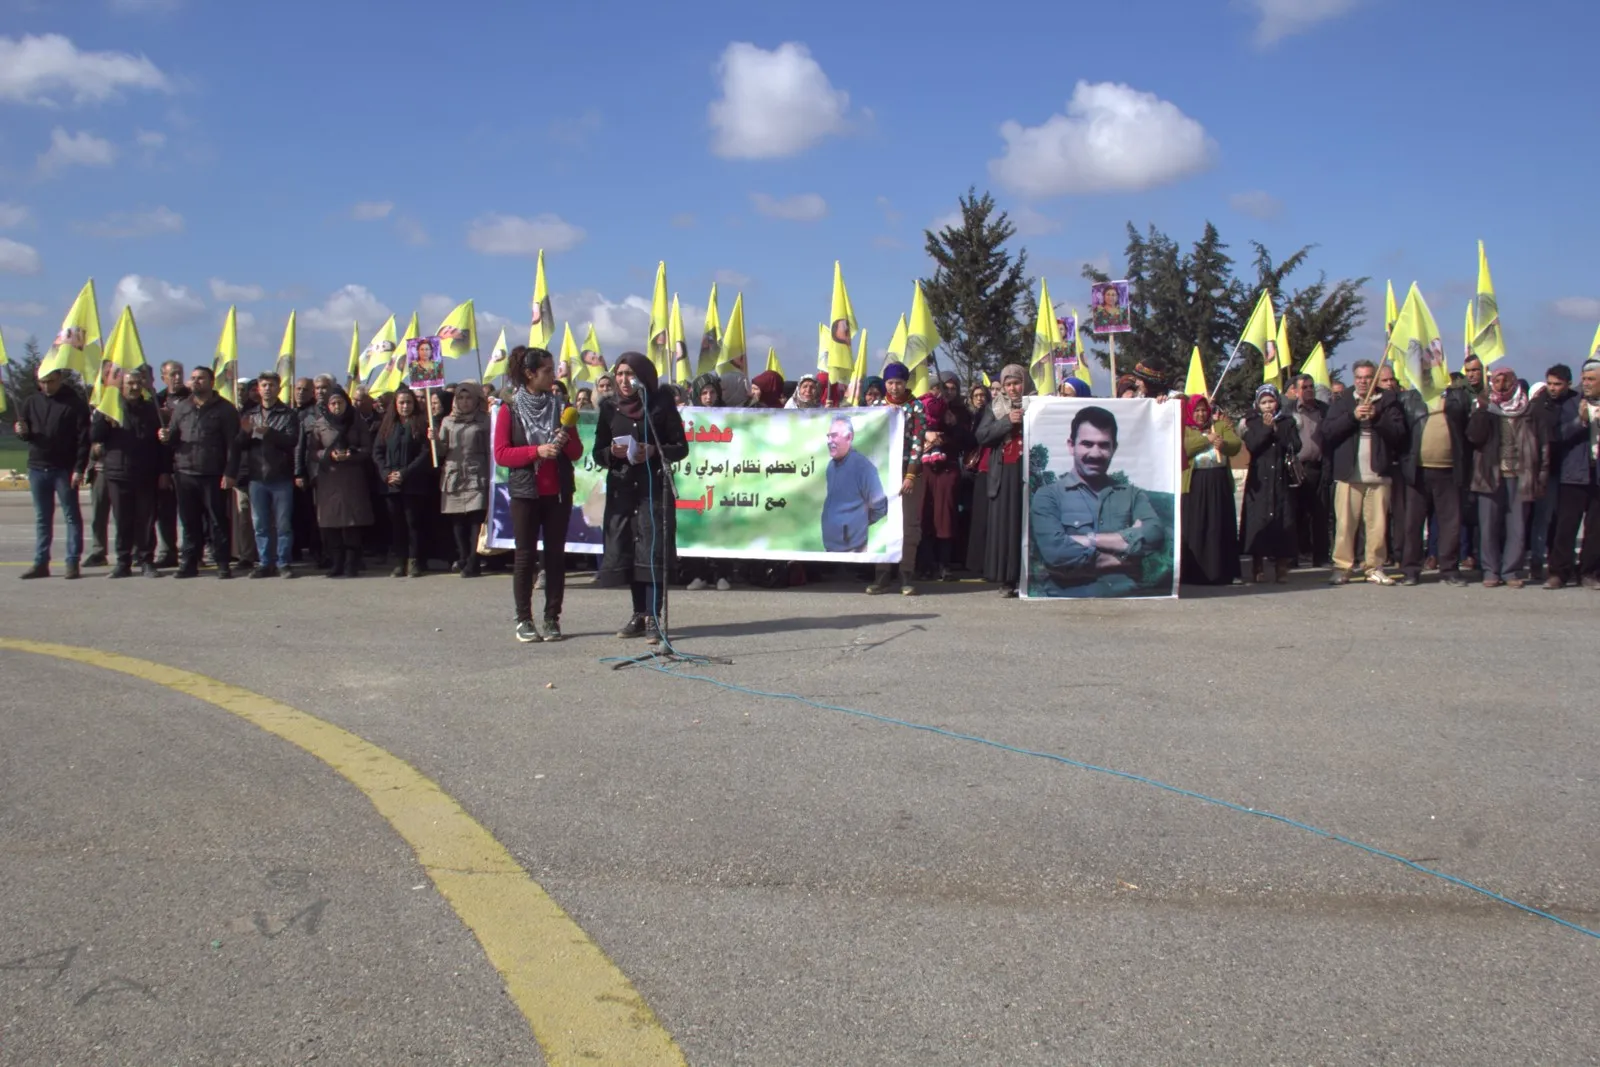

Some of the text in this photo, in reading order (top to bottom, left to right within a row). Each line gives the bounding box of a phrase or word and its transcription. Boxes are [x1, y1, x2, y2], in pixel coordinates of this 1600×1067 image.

[683, 461, 692, 476] و
[695, 459, 729, 480] إمرلي
[733, 459, 760, 479] نظام
[765, 460, 797, 479] نحطم
[801, 456, 815, 478] أن
[719, 492, 759, 508] القائد
[765, 497, 787, 511] مع
